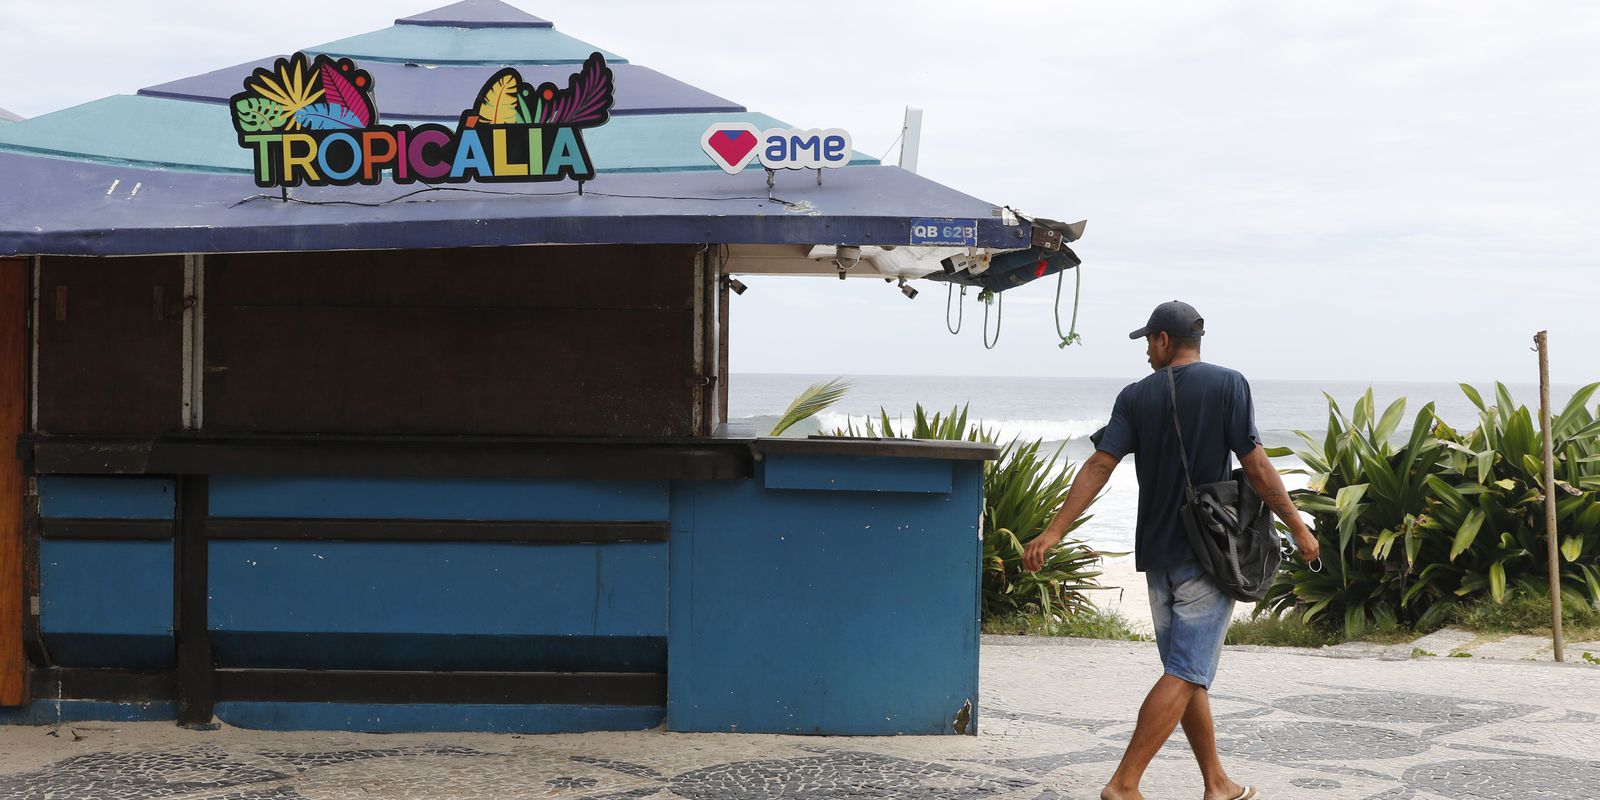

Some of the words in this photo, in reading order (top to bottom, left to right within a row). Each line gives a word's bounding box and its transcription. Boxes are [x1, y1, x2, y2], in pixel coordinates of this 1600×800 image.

[244, 116, 588, 182] TROPICÁLIA
[765, 135, 846, 162] ame
[914, 225, 938, 238] QB
